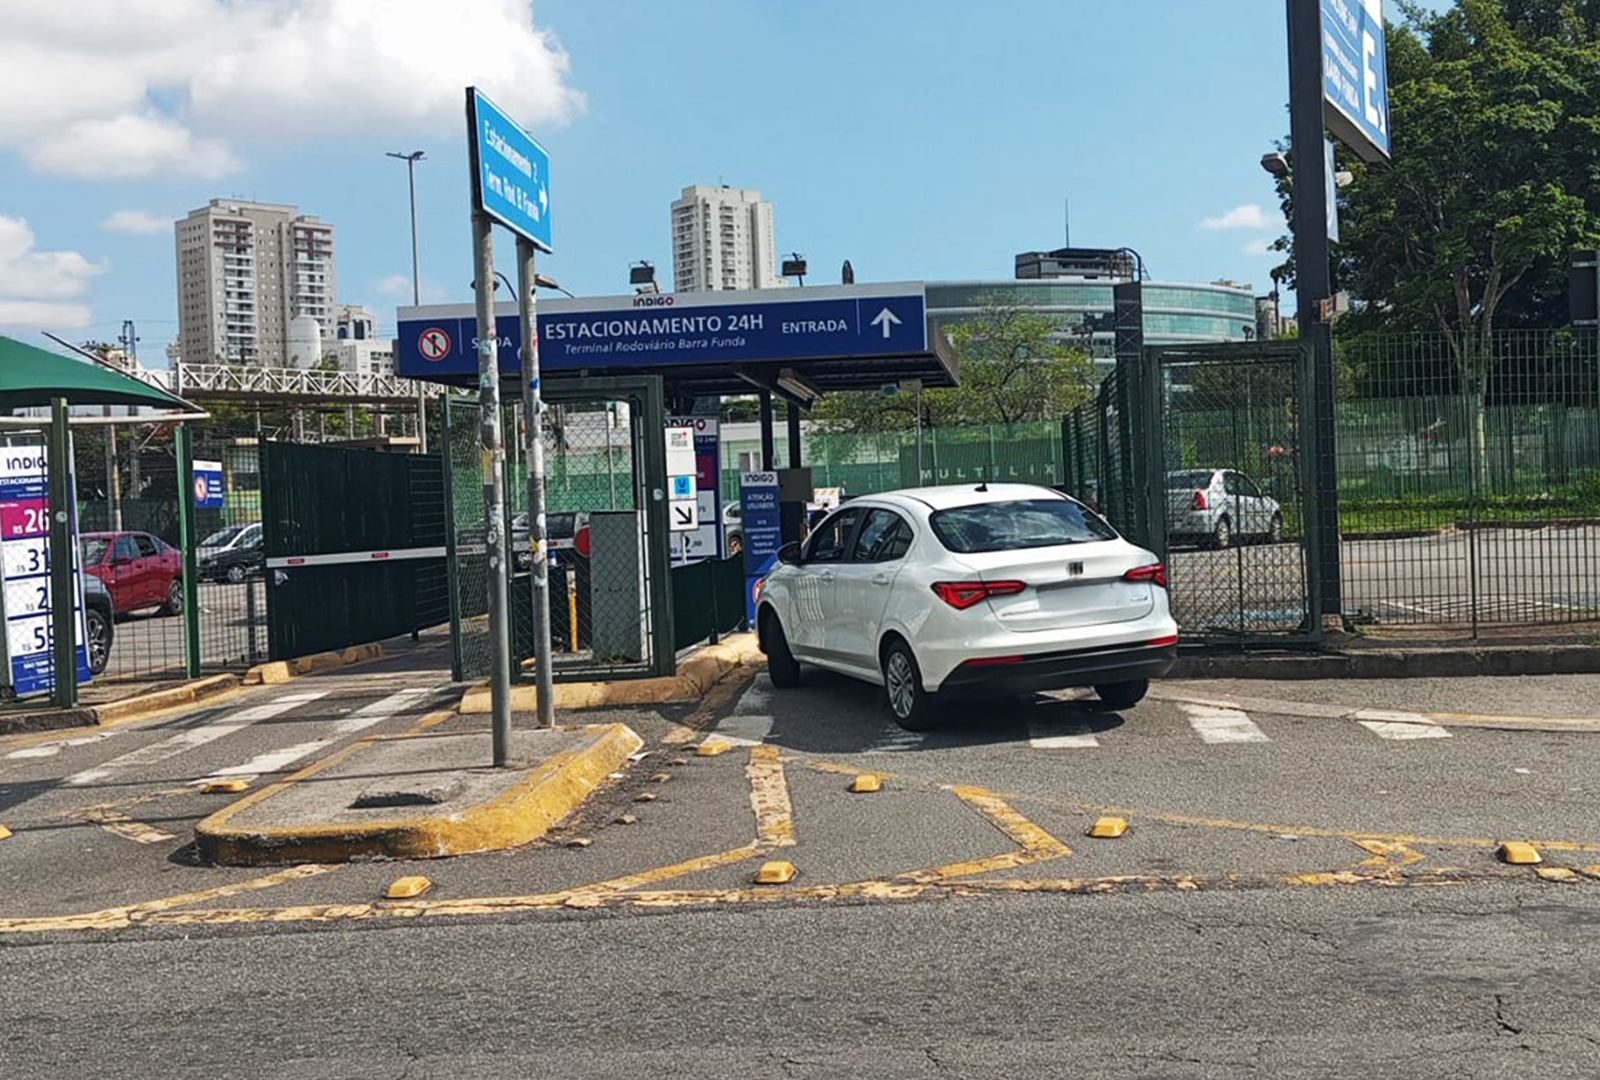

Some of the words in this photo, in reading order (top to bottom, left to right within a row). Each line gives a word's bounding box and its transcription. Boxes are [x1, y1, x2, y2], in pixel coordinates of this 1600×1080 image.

[633, 296, 675, 307] INDIGO
[545, 315, 722, 340] ESTACIONAMENTO
[727, 314, 763, 331] 24H
[782, 319, 847, 334] ENTRADA
[471, 338, 513, 349] SDA
[565, 340, 612, 355] Terminal
[615, 338, 675, 353] Rodoviário
[678, 337, 708, 350] Barra
[711, 335, 746, 348] Funda
[744, 473, 775, 483] INDIGO
